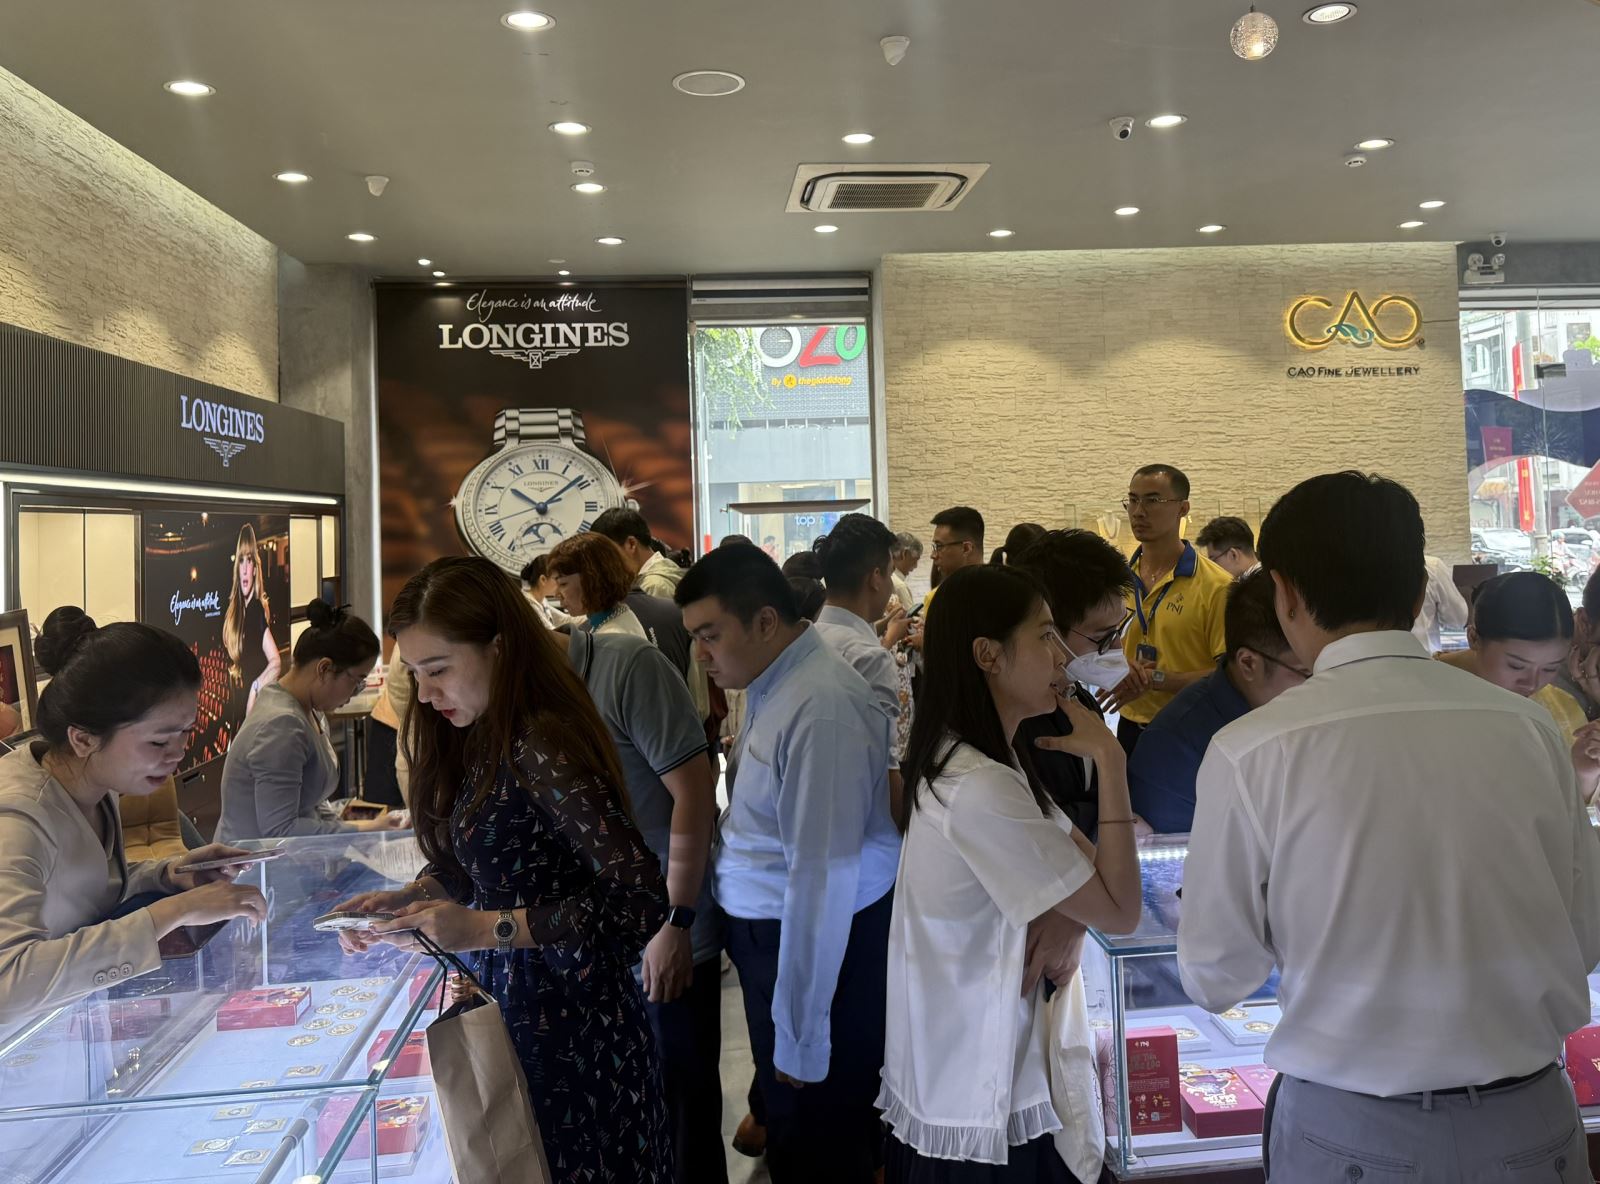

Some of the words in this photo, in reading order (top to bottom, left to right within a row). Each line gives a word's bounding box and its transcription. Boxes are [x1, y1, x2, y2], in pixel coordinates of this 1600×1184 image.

[466, 289, 519, 323] Elegance
[520, 293, 532, 310] is
[533, 298, 549, 312] an
[548, 292, 602, 312] attitude
[1286, 290, 1422, 349] CAO
[438, 322, 630, 349] LONGINES
[1288, 366, 1316, 378] CAO
[1345, 366, 1420, 378] JEWELLERY
[180, 394, 264, 444] LONGINES
[795, 514, 815, 527] top
[1166, 601, 1184, 615] PNJ
